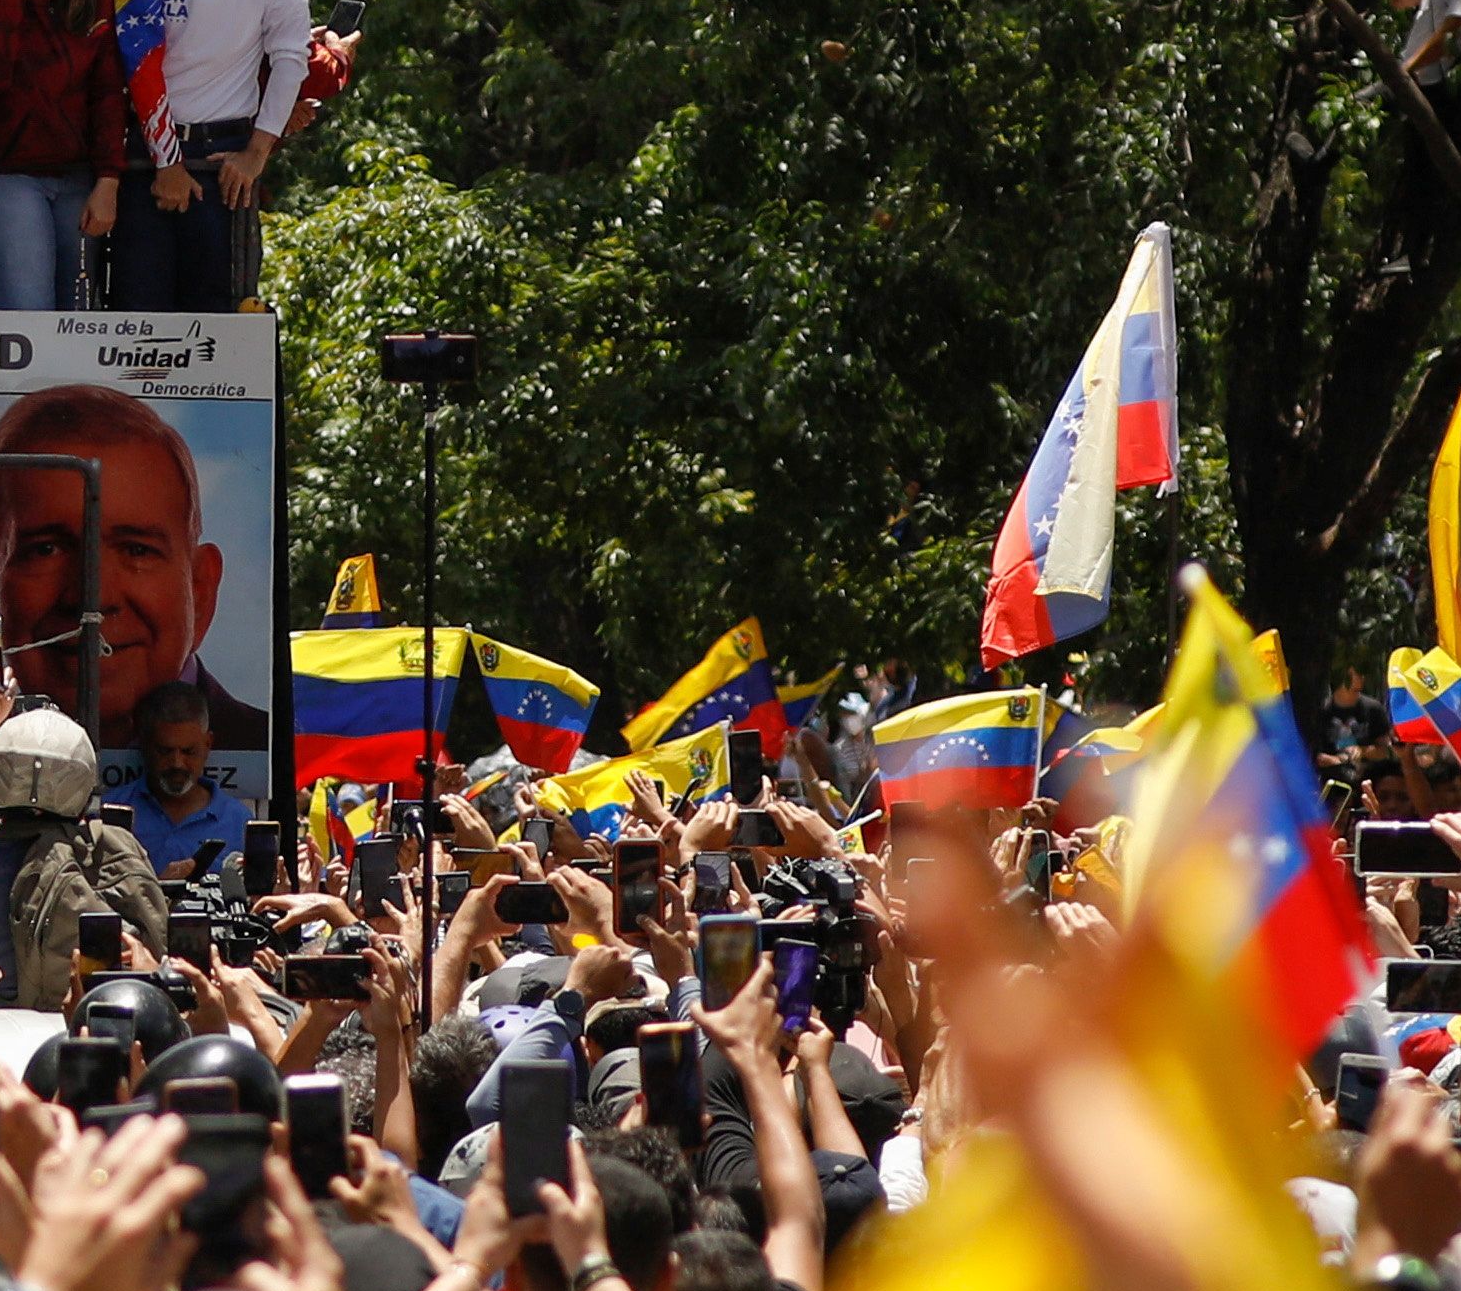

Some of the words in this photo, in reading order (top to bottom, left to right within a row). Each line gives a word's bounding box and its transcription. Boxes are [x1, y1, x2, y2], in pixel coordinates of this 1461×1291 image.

[57, 317, 108, 335] Mesa
[97, 344, 192, 370] Unidad
[141, 380, 247, 398] Democrática
[102, 764, 238, 791] ONEZ
